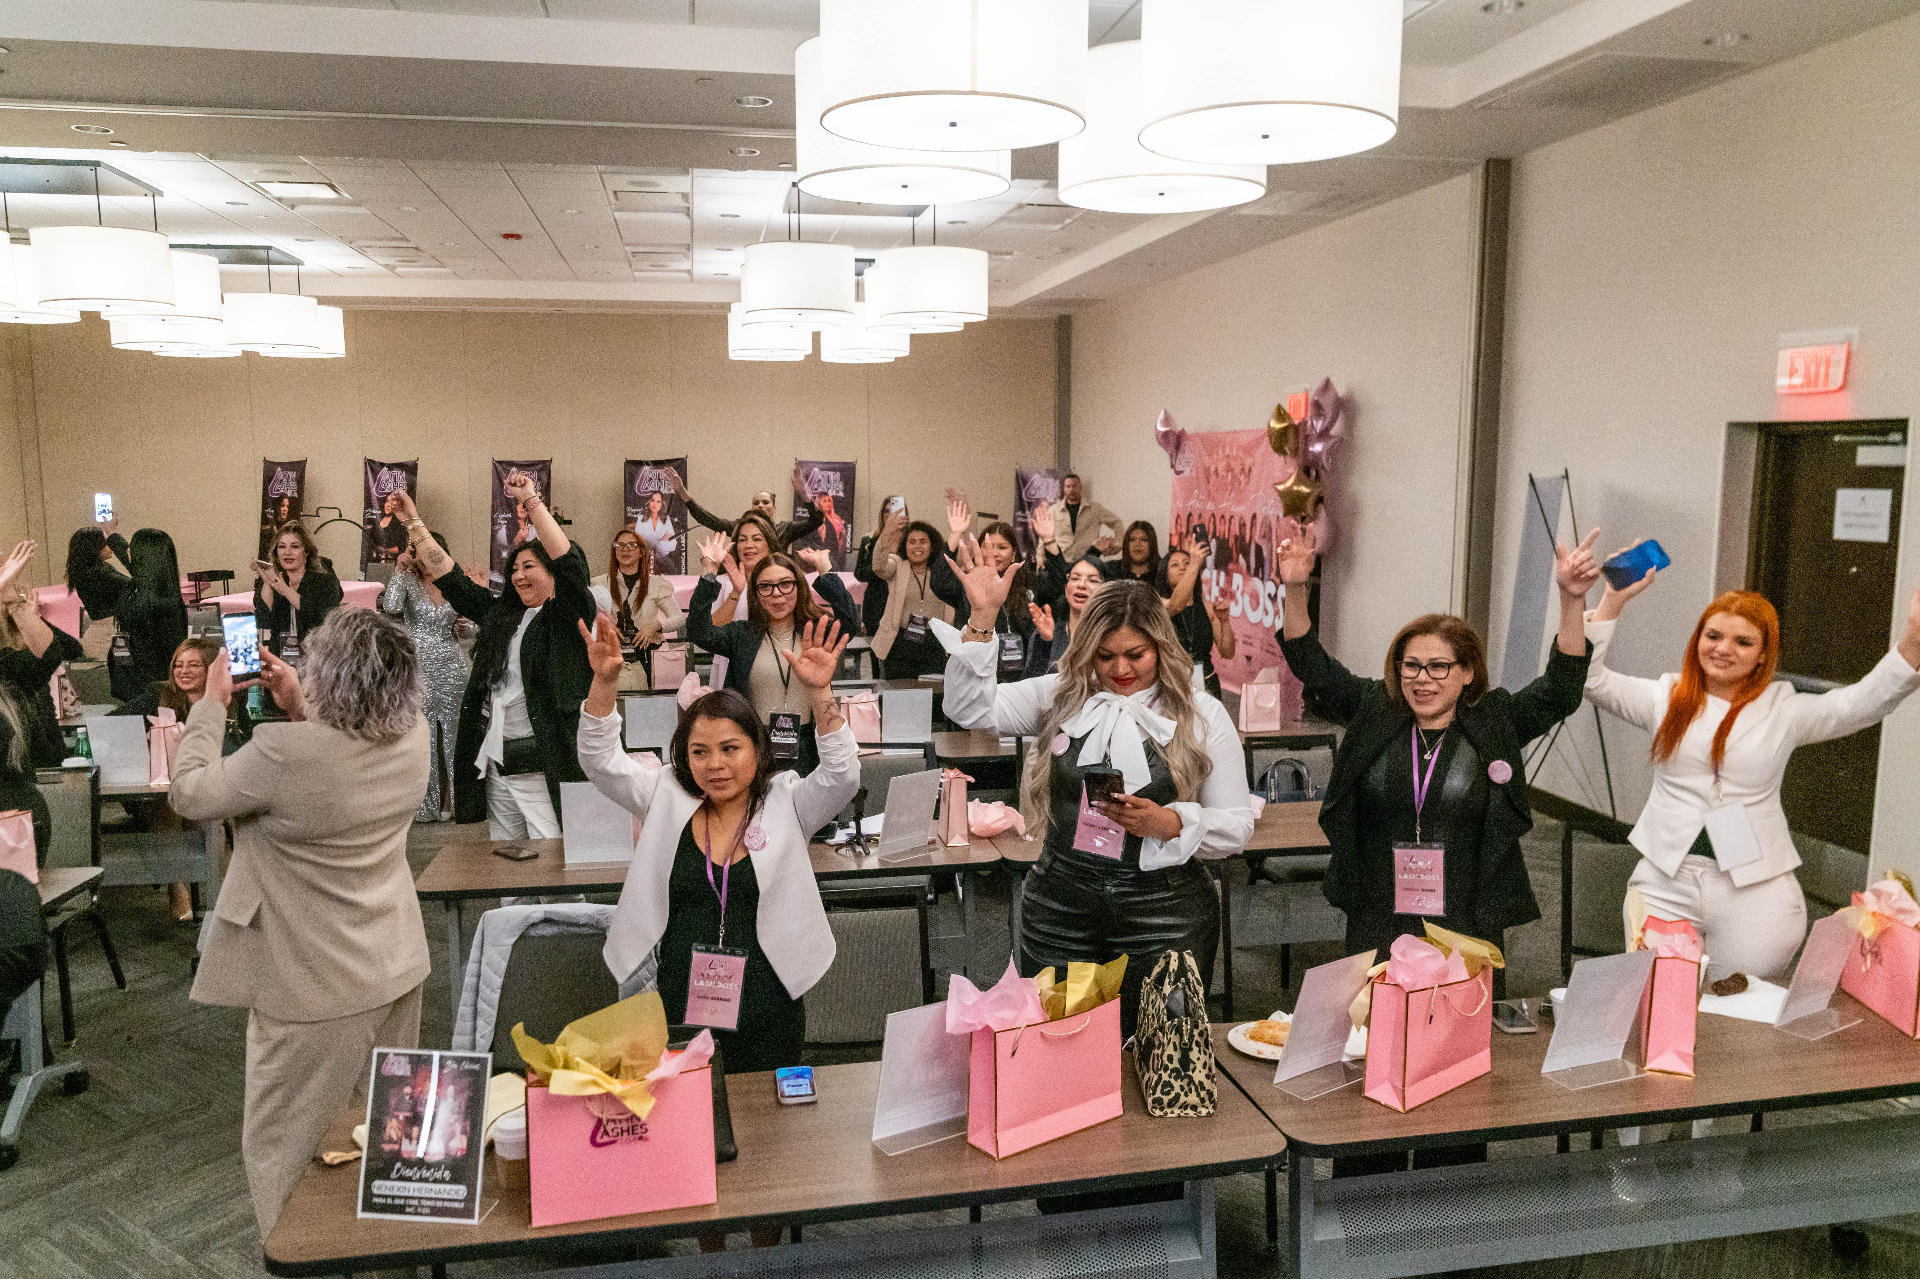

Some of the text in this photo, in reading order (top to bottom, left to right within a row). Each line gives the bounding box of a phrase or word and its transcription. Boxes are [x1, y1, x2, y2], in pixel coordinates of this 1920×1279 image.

[1787, 348, 1836, 389] EXIT
[1230, 573, 1287, 631] BOSS
[694, 979, 739, 990] LASH BOSS
